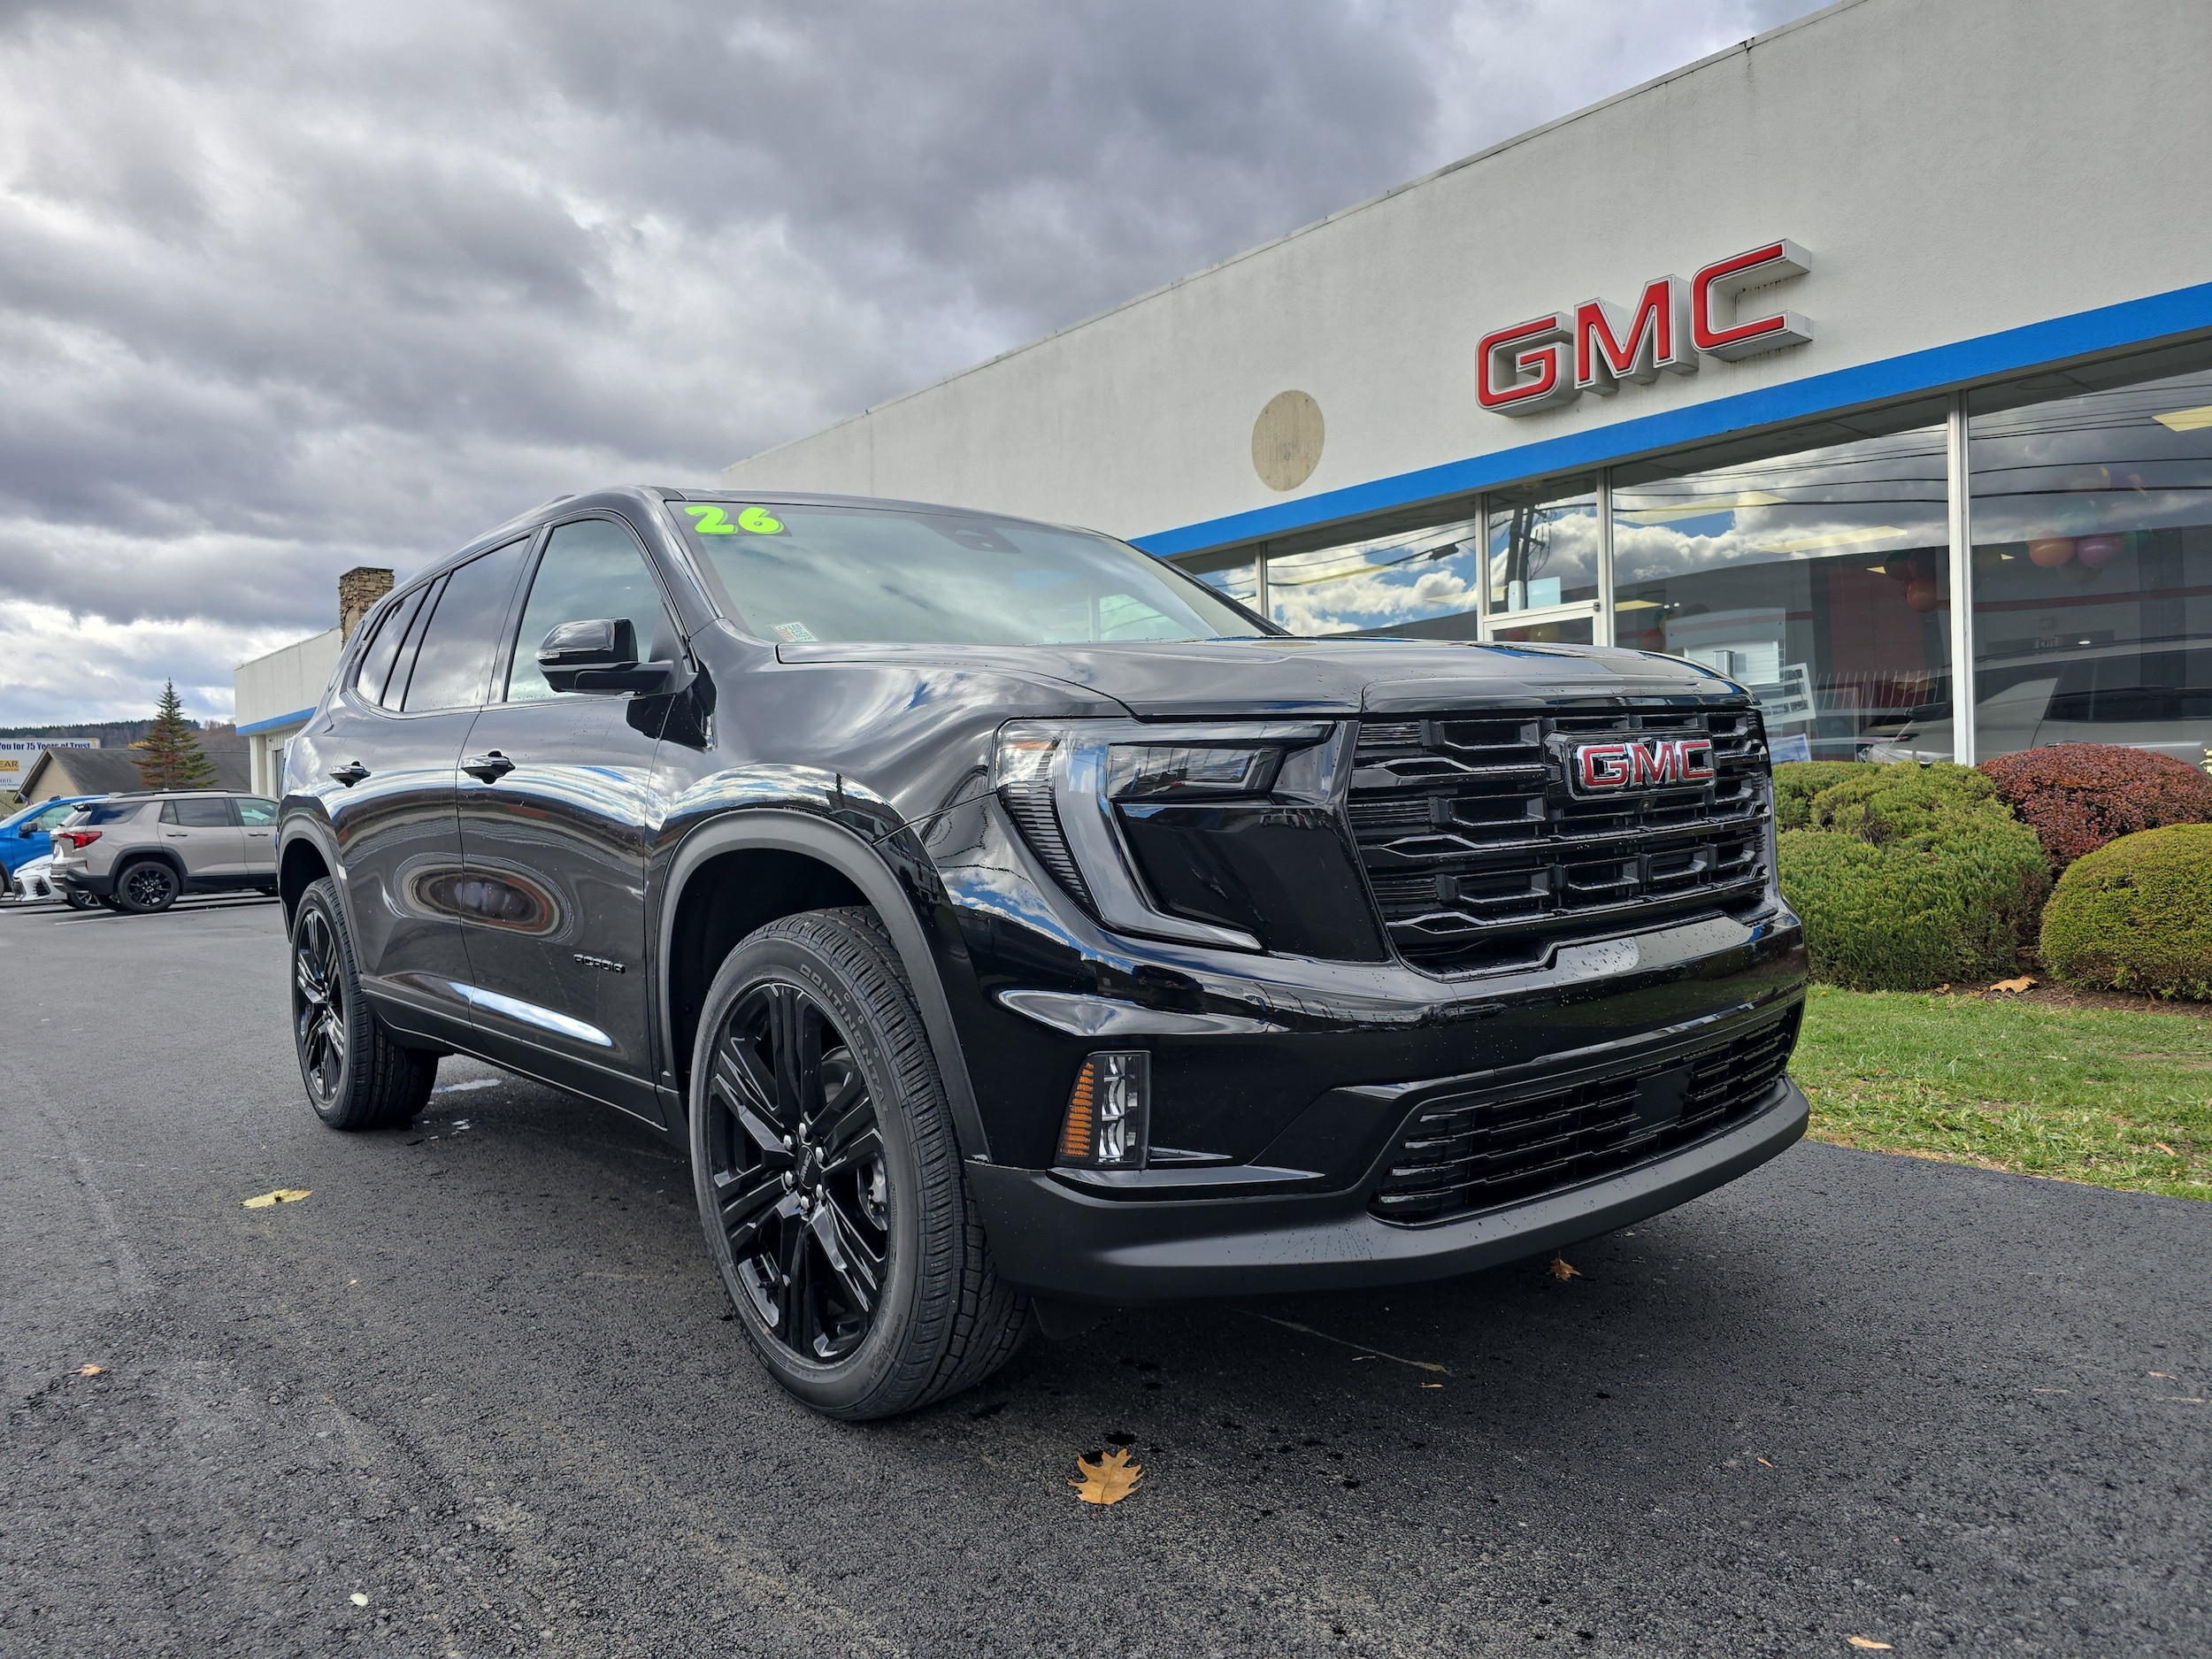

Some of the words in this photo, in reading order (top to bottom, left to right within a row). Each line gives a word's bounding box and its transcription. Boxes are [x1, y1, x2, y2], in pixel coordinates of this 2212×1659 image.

[1475, 238, 1812, 416] GMC
[684, 505, 785, 534] 26
[1577, 738, 1715, 789] GMC
[798, 963, 889, 1124] CONTINENTAL
